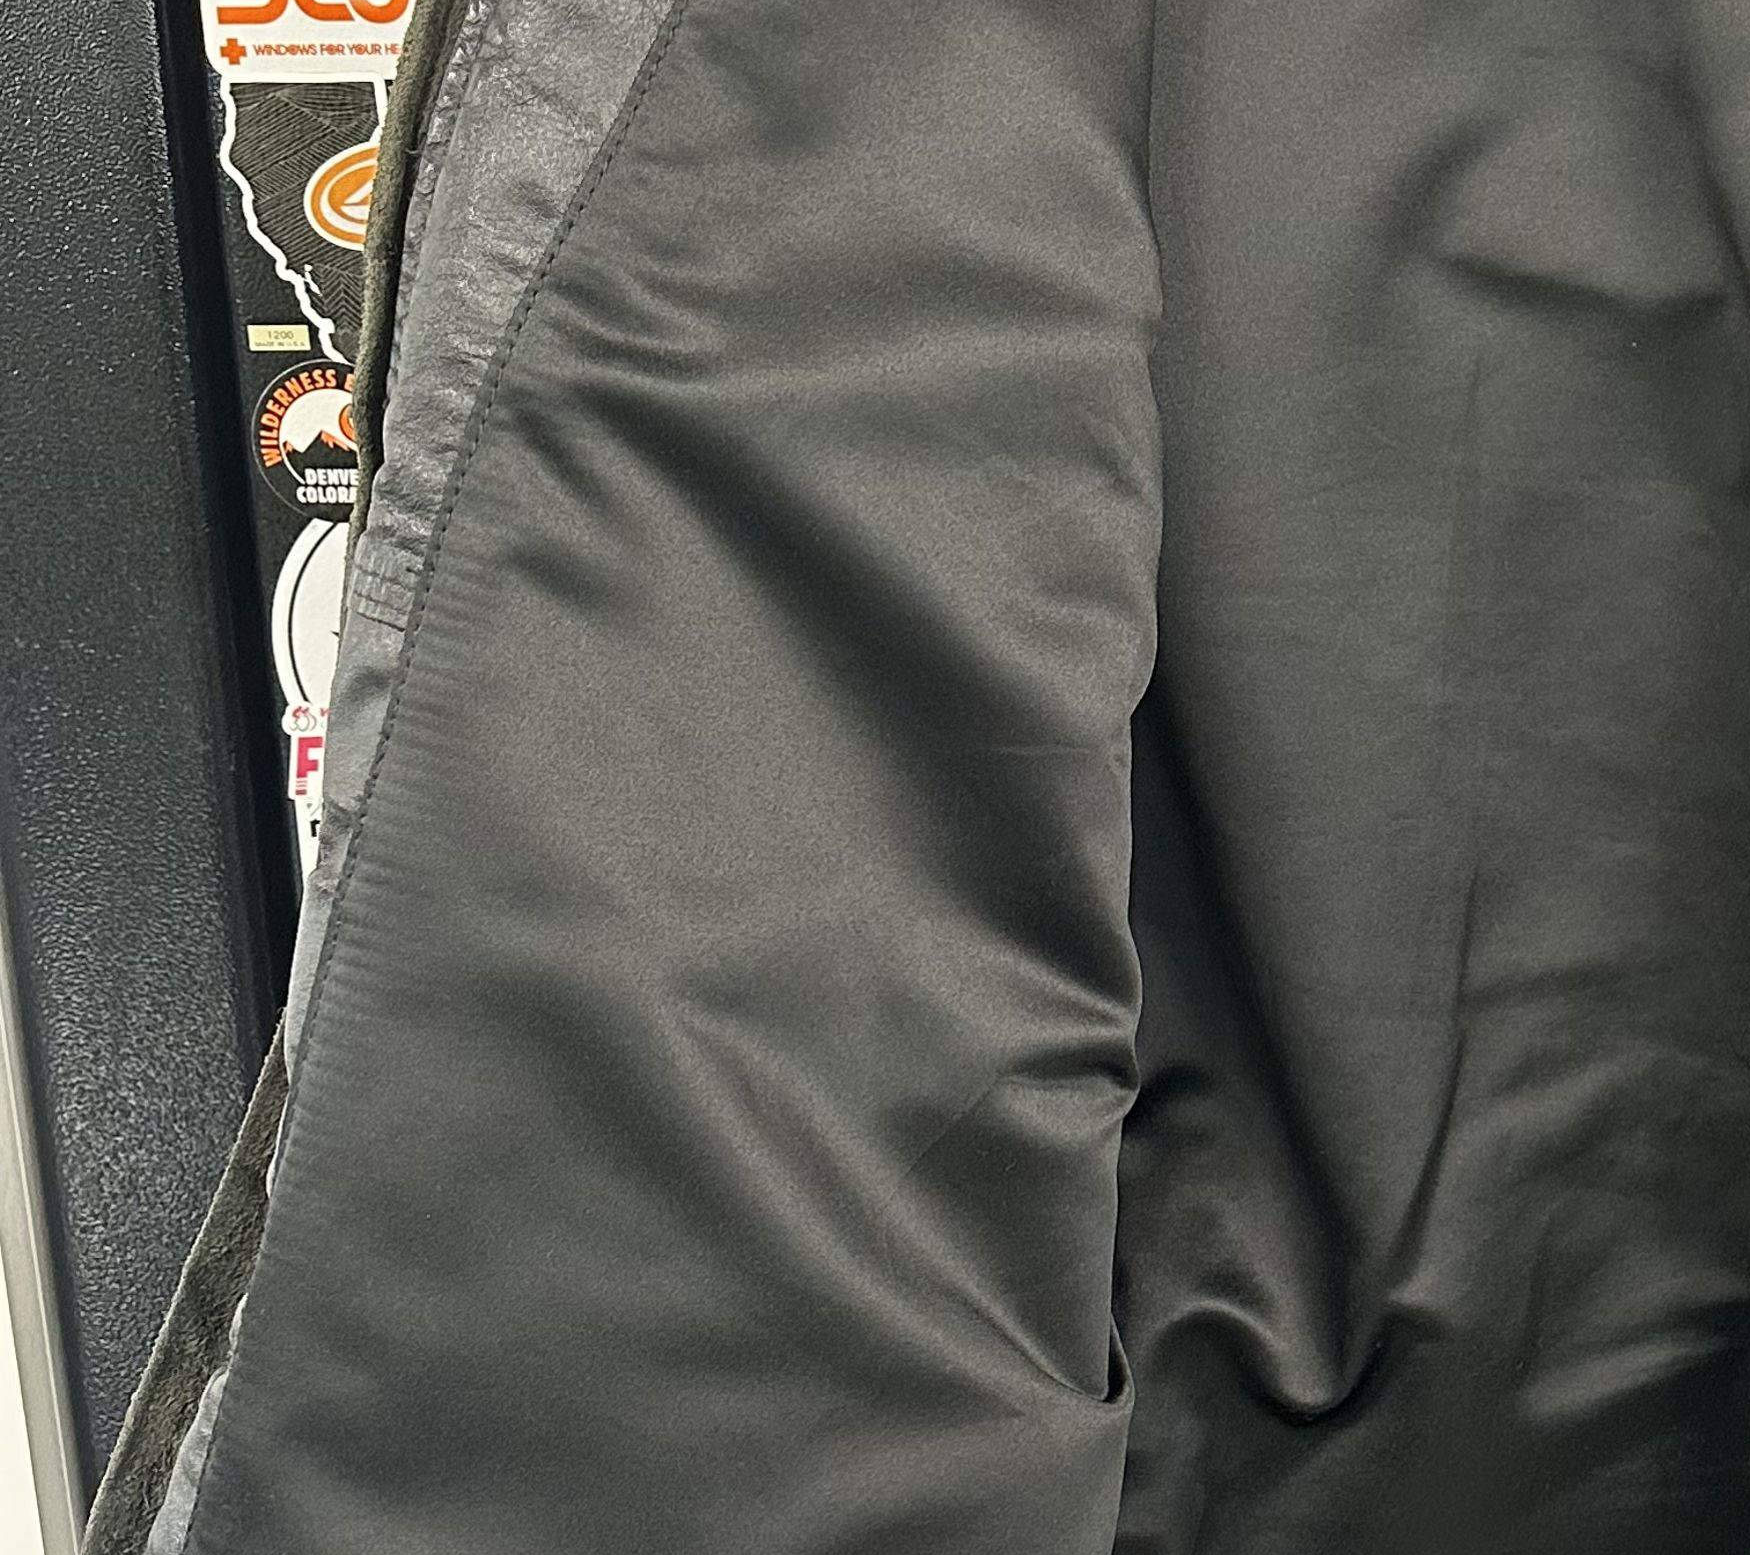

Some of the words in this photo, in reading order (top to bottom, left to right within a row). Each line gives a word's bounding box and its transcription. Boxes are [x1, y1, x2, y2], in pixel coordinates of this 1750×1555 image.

[253, 44, 317, 56] WINDOWS
[320, 44, 345, 56] FOR
[347, 44, 382, 56] YOUR
[260, 369, 337, 468] WILDERNESS
[304, 468, 361, 485] DENVE
